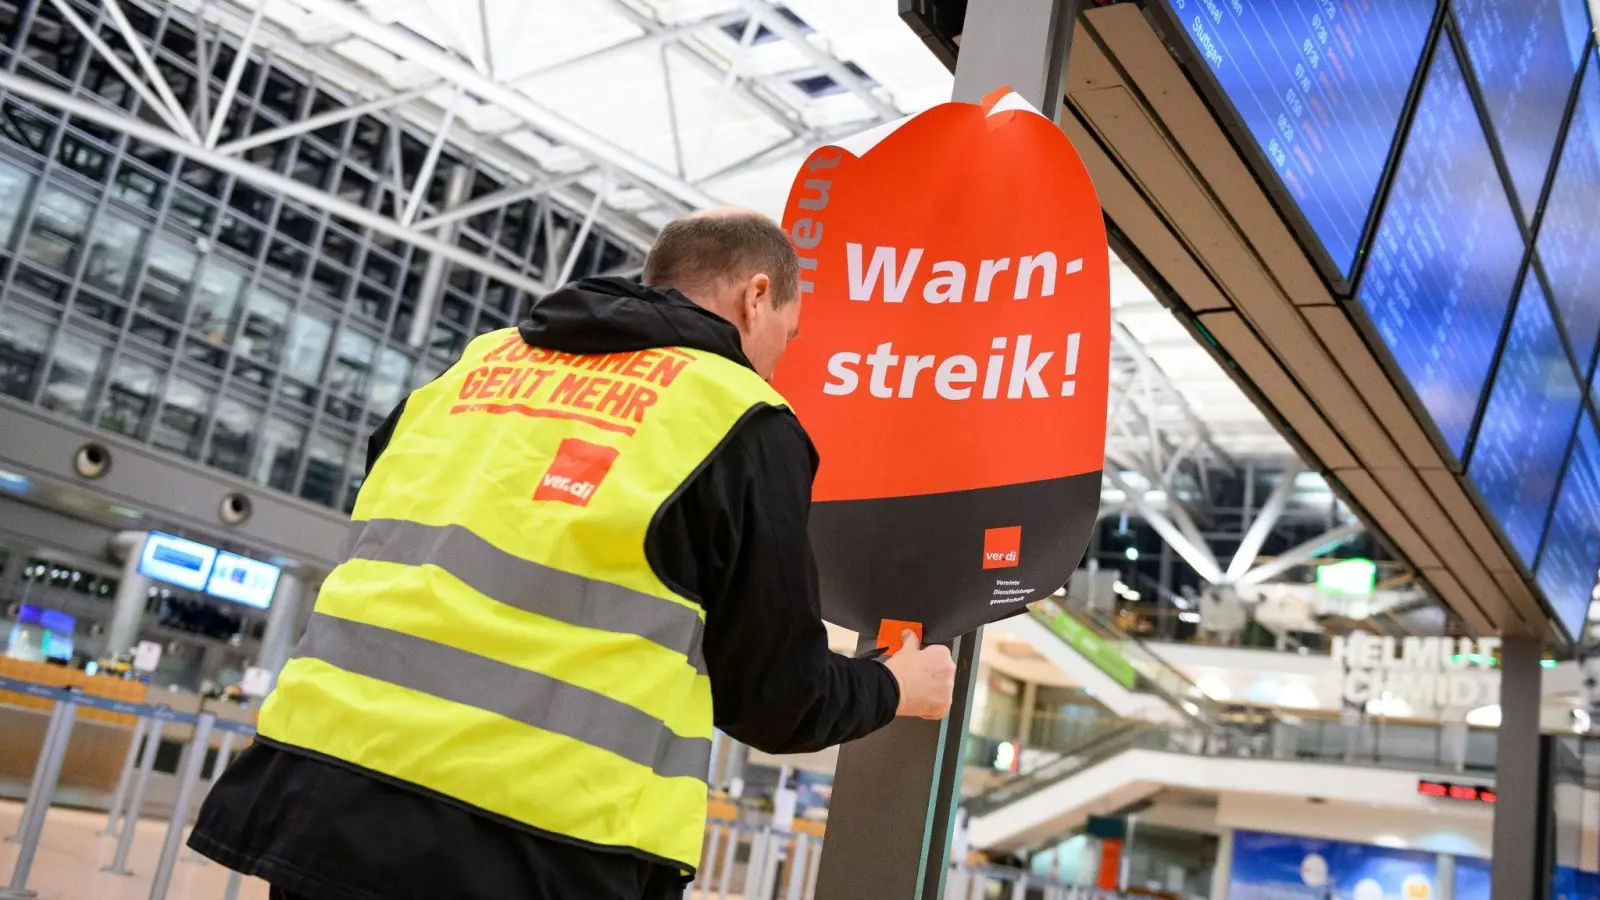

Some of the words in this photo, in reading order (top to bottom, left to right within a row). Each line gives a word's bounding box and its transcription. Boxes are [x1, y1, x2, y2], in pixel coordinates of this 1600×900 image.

[1192, 15, 1222, 69] Stuttgart
[846, 242, 1084, 304] Warn-
[823, 332, 1082, 401] streik!
[458, 366, 557, 401] GEHT
[548, 373, 658, 424] MEHR
[543, 473, 596, 499] ver.di
[1331, 635, 1501, 669] HELMUT
